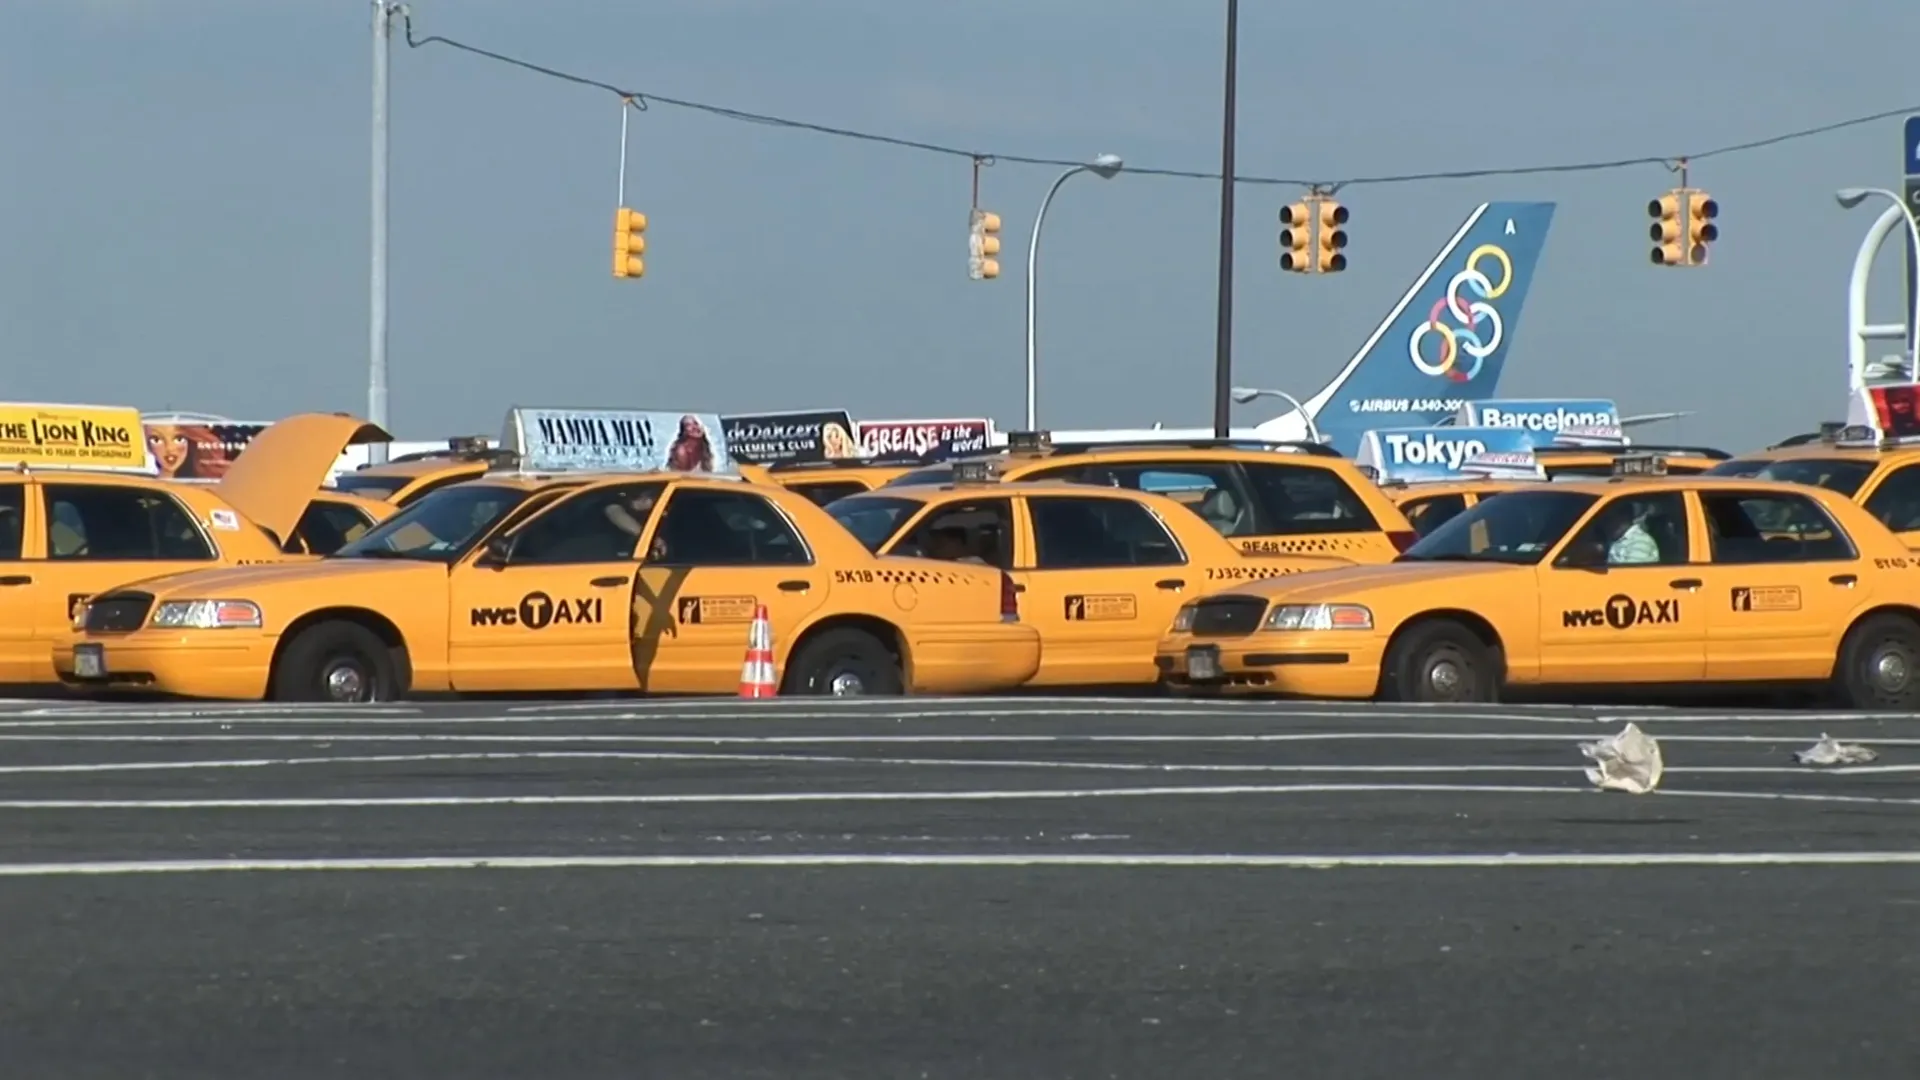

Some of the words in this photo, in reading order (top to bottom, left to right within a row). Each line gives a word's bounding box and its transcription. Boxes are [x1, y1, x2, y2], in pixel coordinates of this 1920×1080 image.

[1505, 217, 1516, 235] A
[1361, 399, 1409, 412] AIRBUS
[1482, 407, 1610, 431] Barcelona
[31, 418, 78, 445] LION
[81, 420, 131, 447] KING
[538, 418, 609, 446] MAMMA
[611, 419, 654, 447] MIA!
[787, 439, 816, 450] CLUB
[864, 426, 939, 457] GREASE
[942, 426, 951, 441] is
[953, 425, 972, 440] the
[951, 435, 984, 452] word!
[1385, 433, 1485, 470] Tokyo
[834, 569, 874, 583] 5K18
[471, 608, 517, 626] NYC
[520, 594, 603, 627] TAXI
[1563, 608, 1605, 627] NYC
[1607, 595, 1679, 627] TAXI
